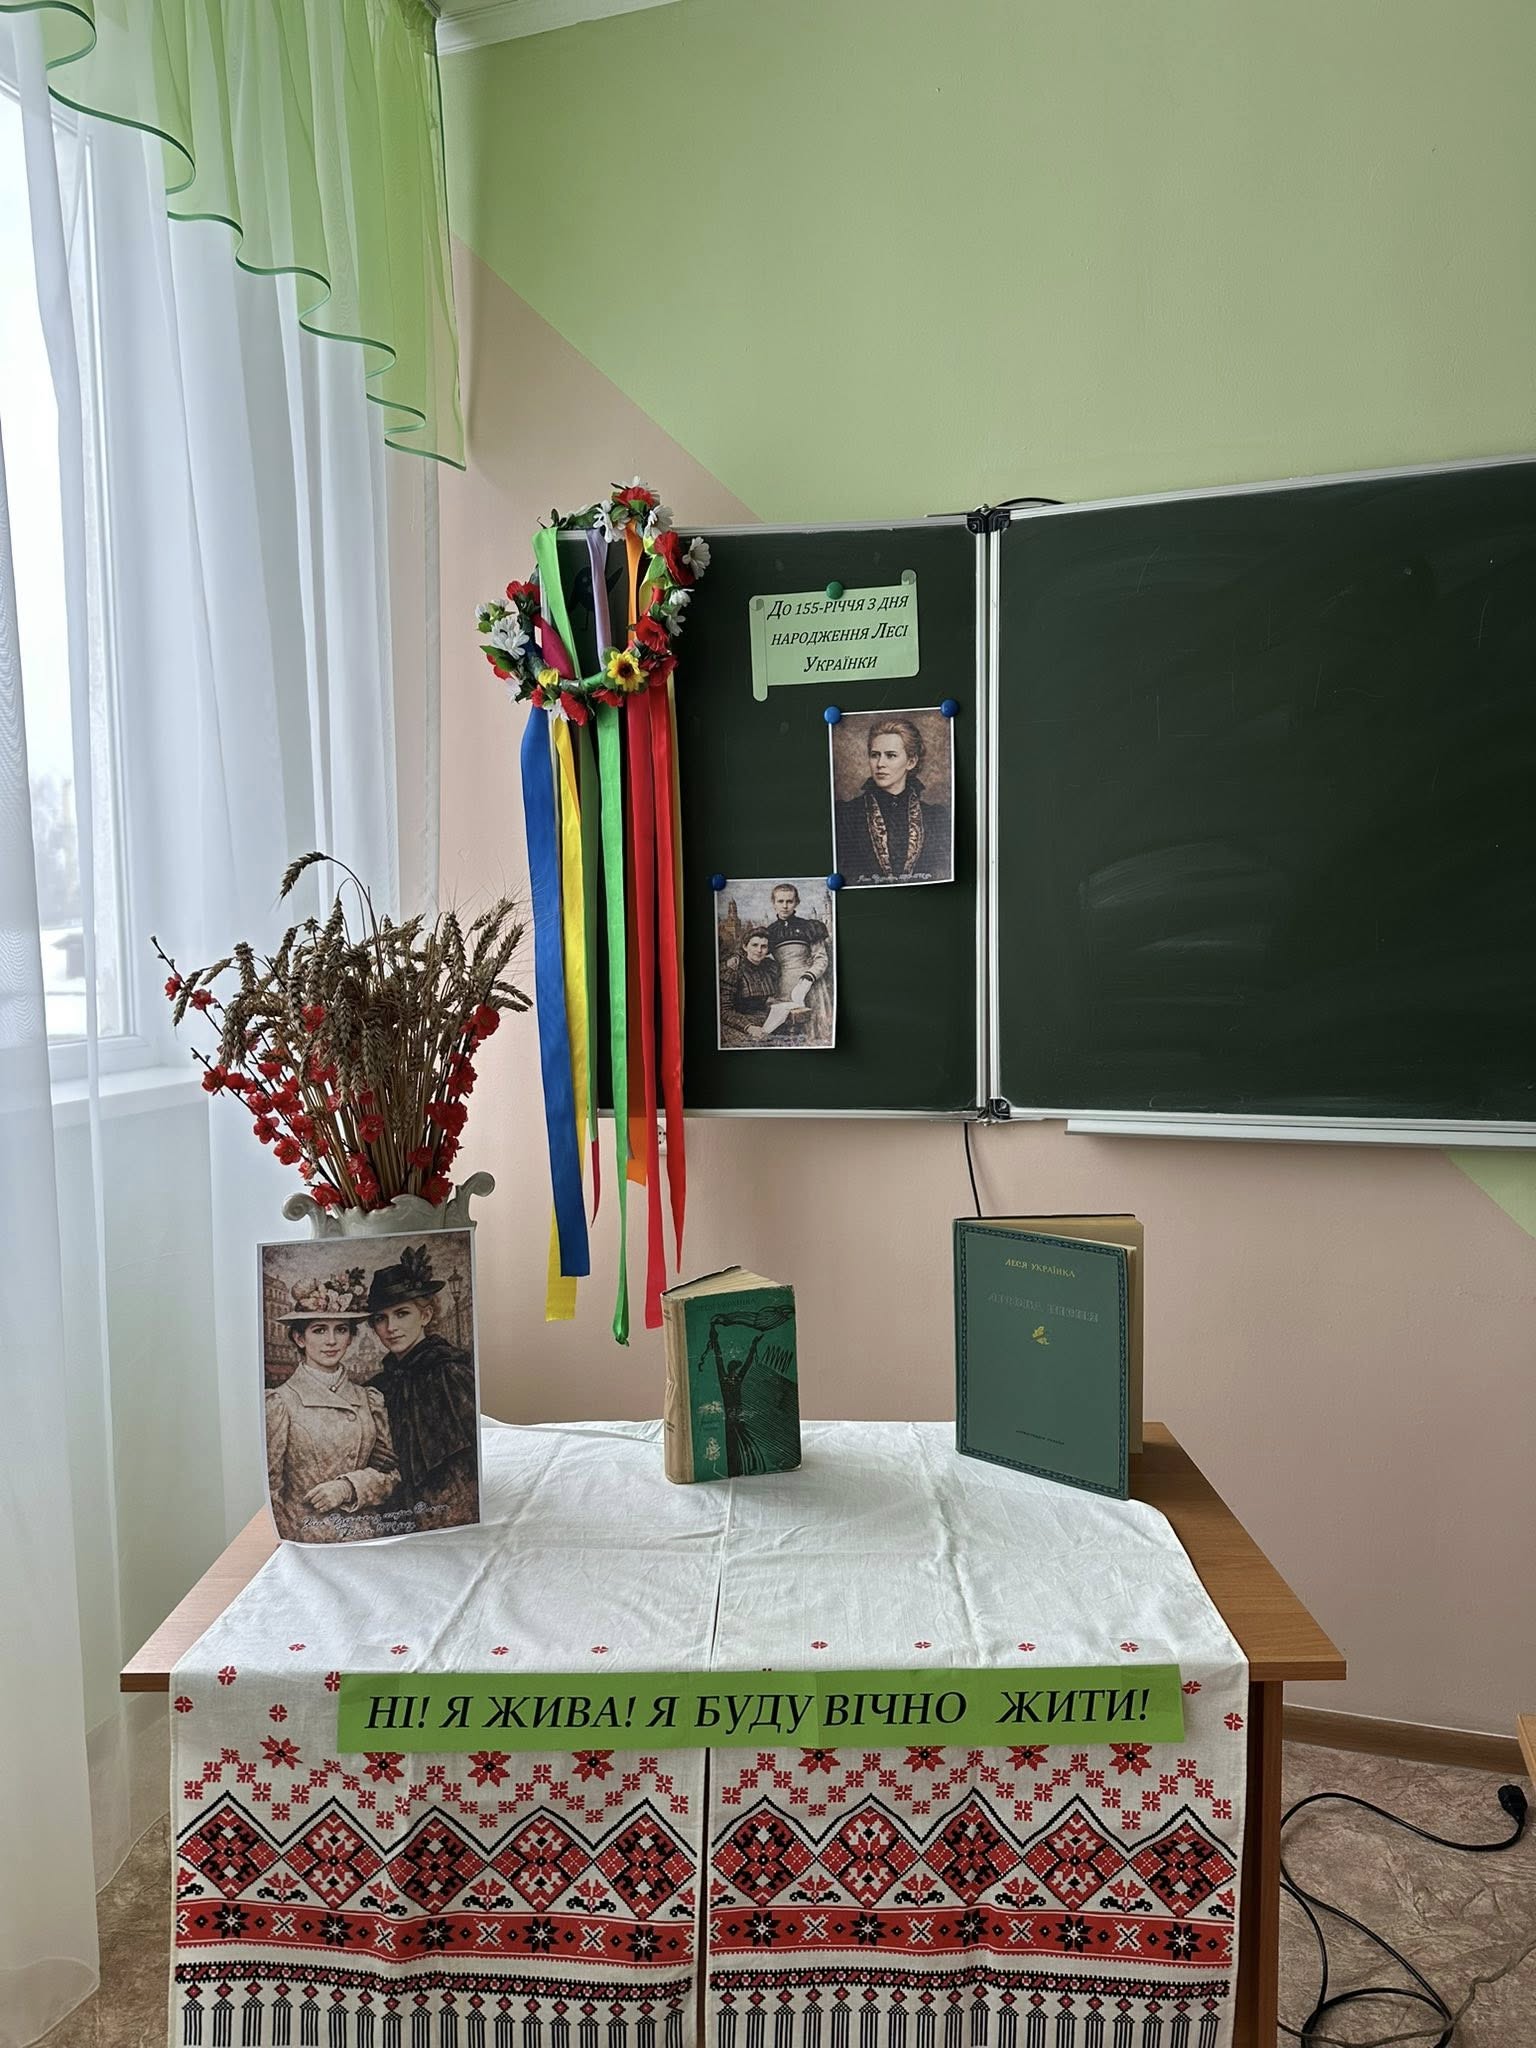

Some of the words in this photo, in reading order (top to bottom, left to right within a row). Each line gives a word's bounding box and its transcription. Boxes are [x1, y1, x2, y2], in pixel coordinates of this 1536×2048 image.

[795, 599, 865, 616] 155-РІЧЧЯ
[877, 595, 909, 611] ДНЯ
[771, 627, 870, 646] НАРОДЖЕННЯ
[871, 622, 909, 639] ЛЕСІ
[803, 655, 878, 673] УКРАЇНКИ
[364, 1695, 431, 1729] НІ!
[439, 1695, 474, 1729] Я
[481, 1695, 636, 1729] ЖИВА!
[645, 1695, 681, 1728] Я
[694, 1693, 815, 1735] БУДУ
[822, 1691, 968, 1727] ВІЧНО
[994, 1688, 1152, 1724] ЖИТИ!
